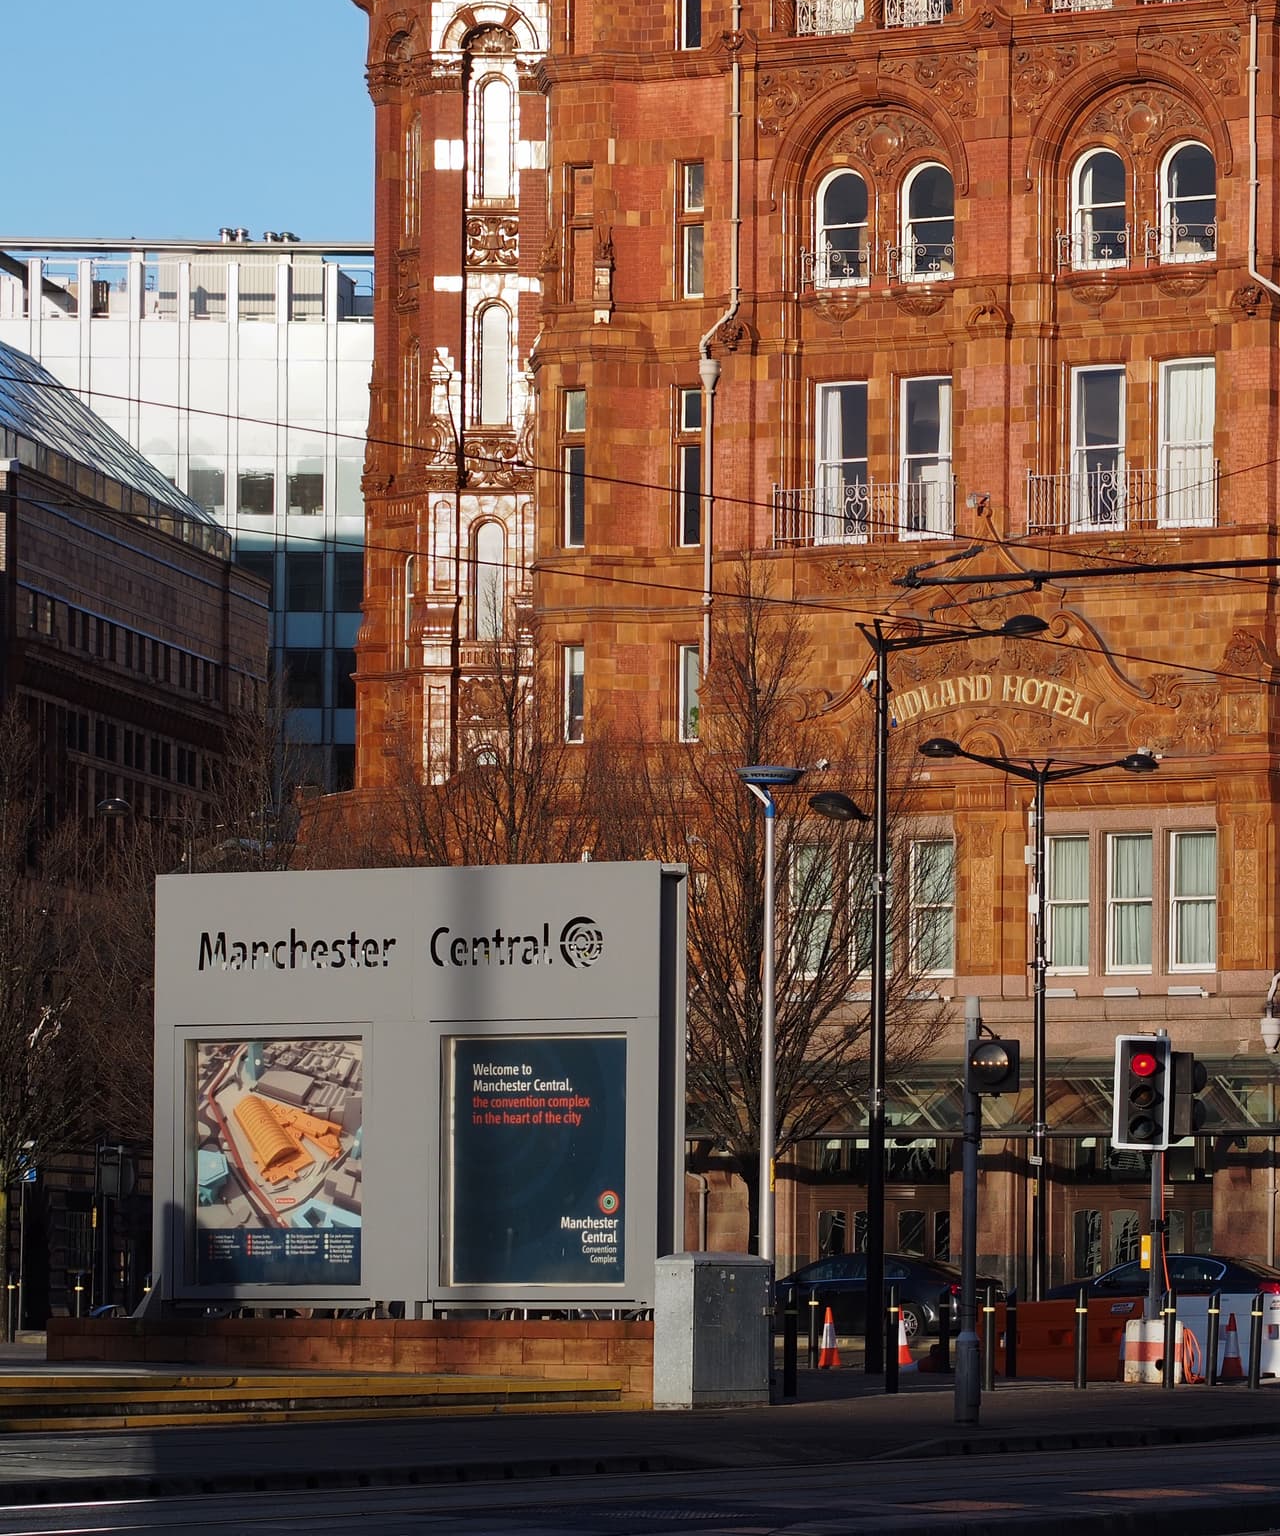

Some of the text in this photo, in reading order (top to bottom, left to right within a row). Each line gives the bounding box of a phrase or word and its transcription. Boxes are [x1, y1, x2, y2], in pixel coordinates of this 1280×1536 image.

[1003, 675, 1090, 726] HOTEL
[198, 923, 553, 971] Manchester Central
[472, 1063, 533, 1076] Welcome to
[472, 1078, 573, 1093] Manchester Central,
[472, 1094, 591, 1110] the convention complex
[472, 1111, 582, 1127] in the heart of the city
[560, 1215, 619, 1229] Manchester
[581, 1230, 617, 1243] Central
[582, 1244, 617, 1254] Convention
[590, 1254, 617, 1265] Complex
